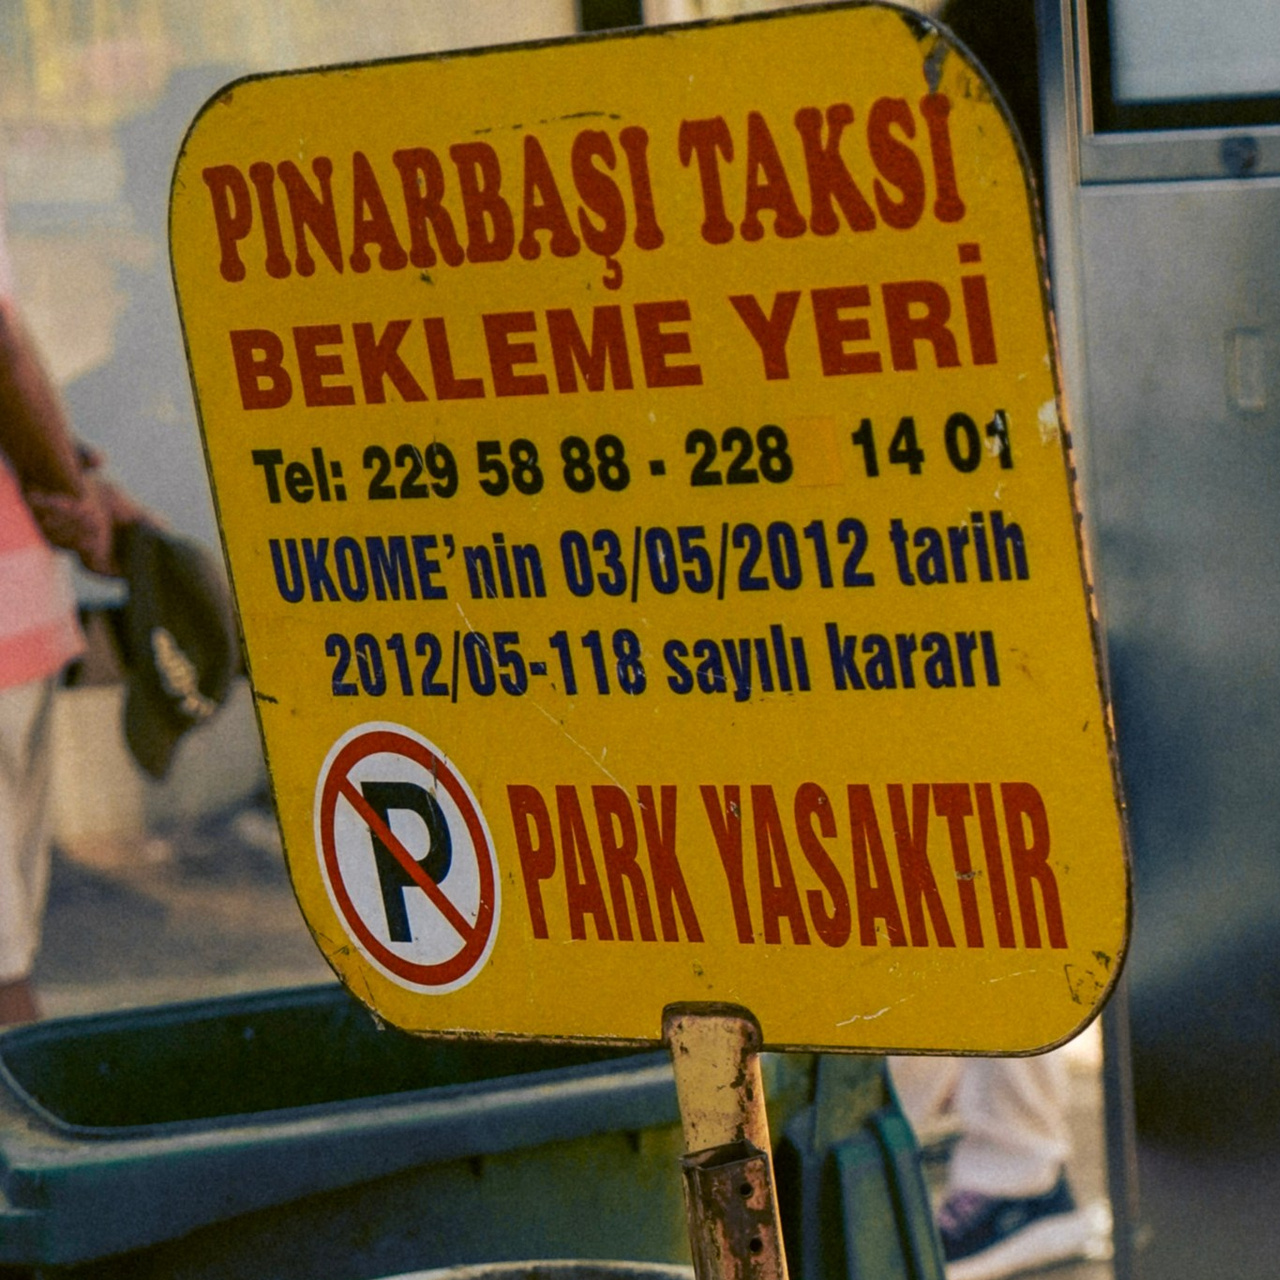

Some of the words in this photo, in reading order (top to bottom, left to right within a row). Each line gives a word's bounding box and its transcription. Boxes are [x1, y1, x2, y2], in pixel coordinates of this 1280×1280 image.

[202, 127, 664, 290] PINARBAŞI
[230, 300, 703, 410] BEKLEME
[729, 243, 997, 380] YERİ
[251, 447, 347, 503] Tel:
[363, 441, 458, 500] 229
[477, 439, 544, 496] 58
[560, 434, 630, 493] 88
[649, 460, 665, 476] -
[685, 425, 793, 487] 228
[852, 417, 924, 477] 14
[944, 410, 1013, 473] 01
[269, 533, 546, 603] UKOME'nin
[560, 518, 875, 602] 03/05/2012
[889, 511, 1029, 586] tarih
[325, 629, 646, 703] 2012/05-118
[663, 624, 811, 702] sayılı
[825, 623, 1000, 690] kararı
[507, 785, 704, 942] PARK
[700, 782, 1067, 948] YASAKTIR
